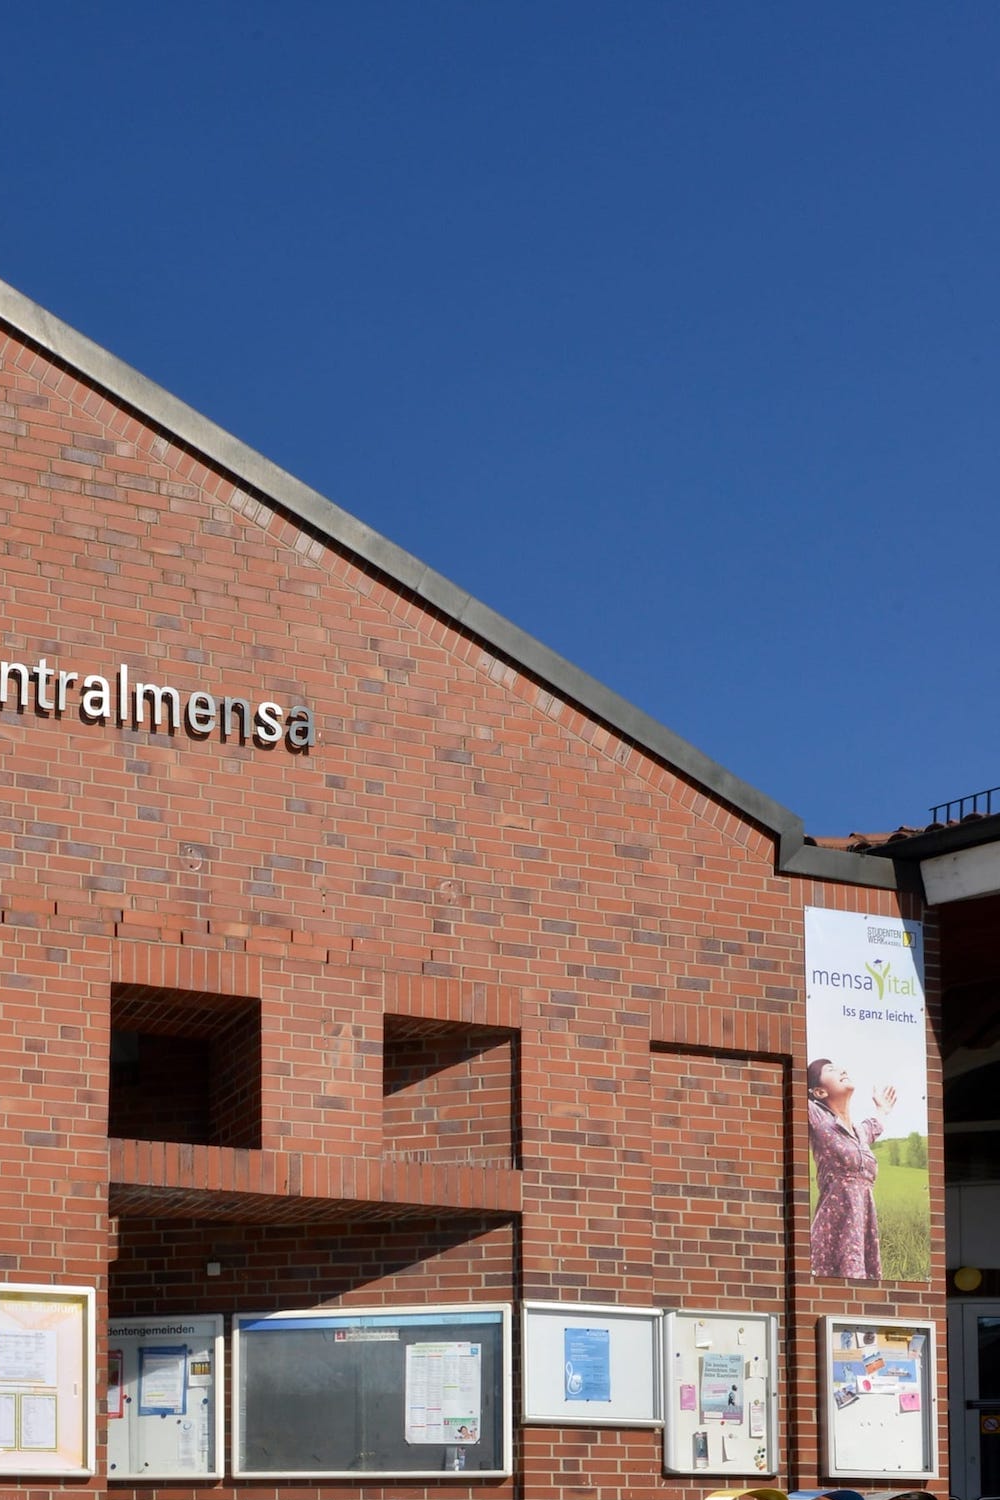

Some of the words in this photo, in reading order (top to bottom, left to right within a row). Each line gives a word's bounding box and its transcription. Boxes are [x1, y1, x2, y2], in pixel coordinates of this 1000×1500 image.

[842, 1005, 857, 1017] Iss
[859, 1008, 883, 1021] ganz
[886, 1009, 918, 1024] leicht.
